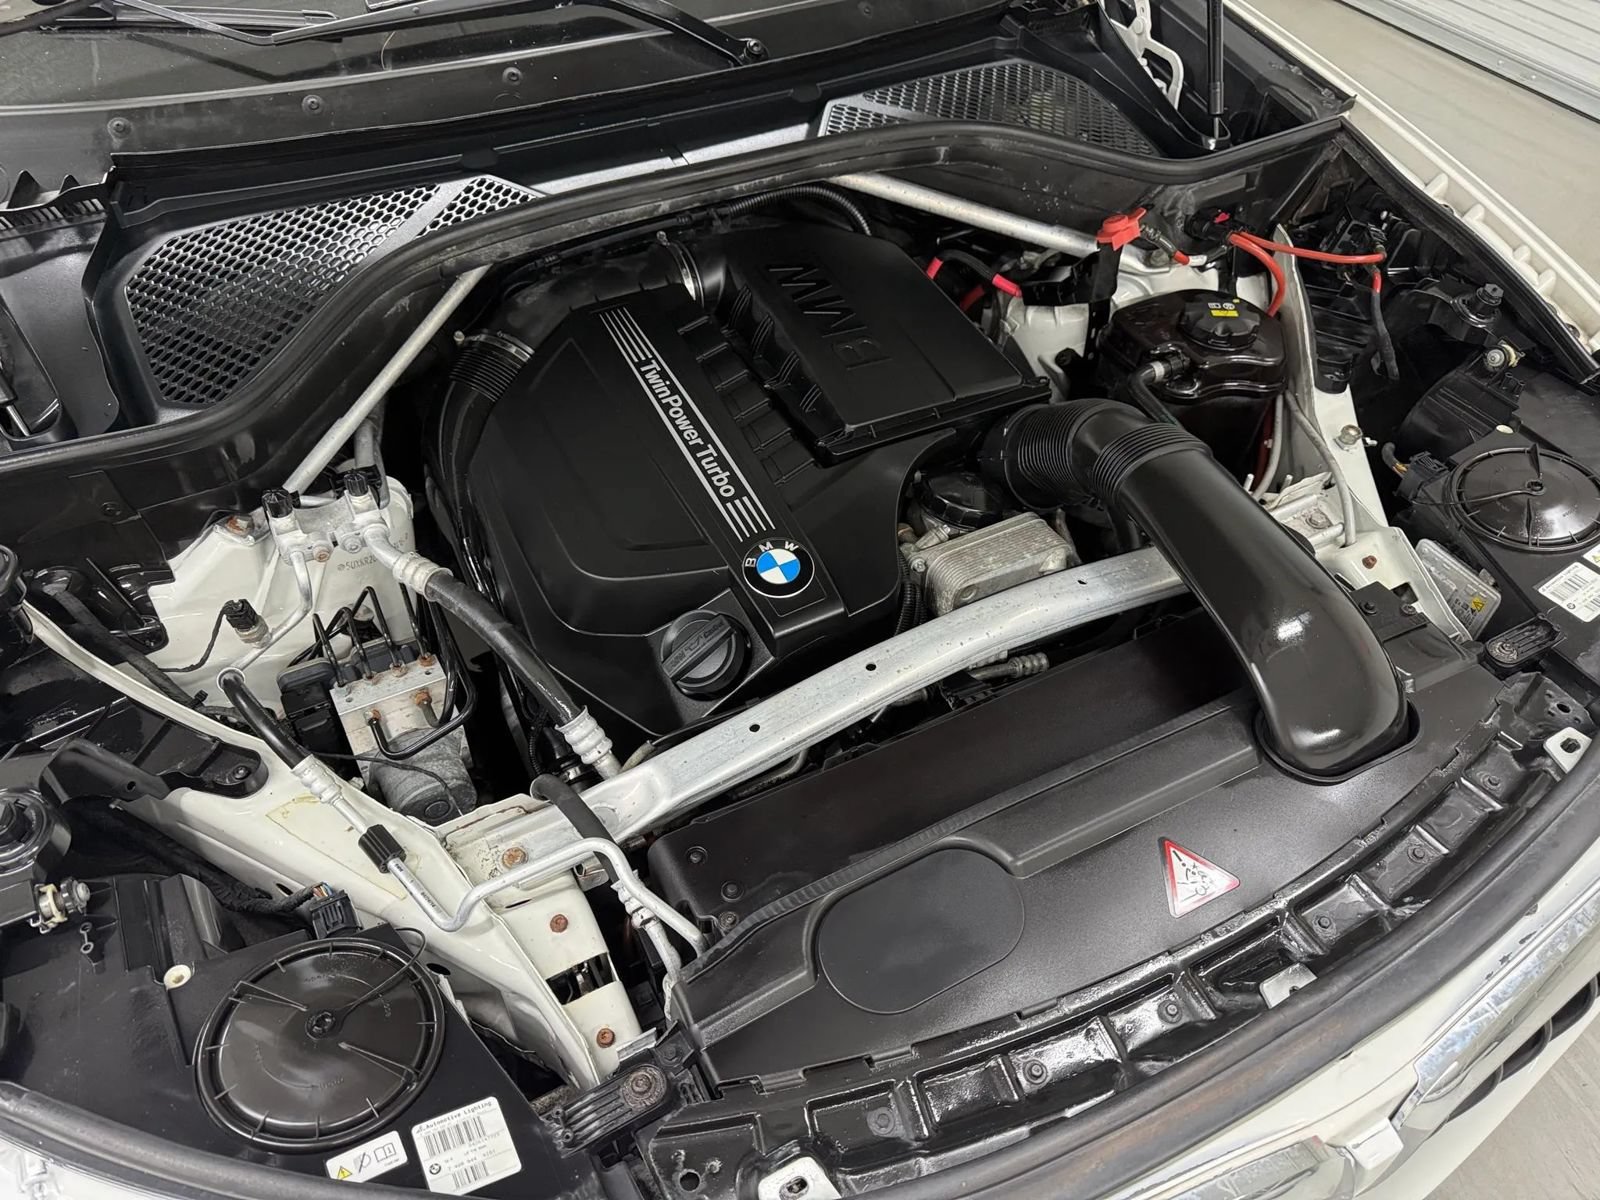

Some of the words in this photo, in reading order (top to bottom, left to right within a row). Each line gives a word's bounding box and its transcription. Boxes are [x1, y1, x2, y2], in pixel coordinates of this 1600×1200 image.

[766, 265, 893, 371] BMW
[640, 359, 704, 446] TwinPower
[696, 444, 735, 498] Turbo
[744, 540, 800, 568] BMW
[426, 1112, 461, 1129] Automotive
[463, 1101, 492, 1115] Lighting
